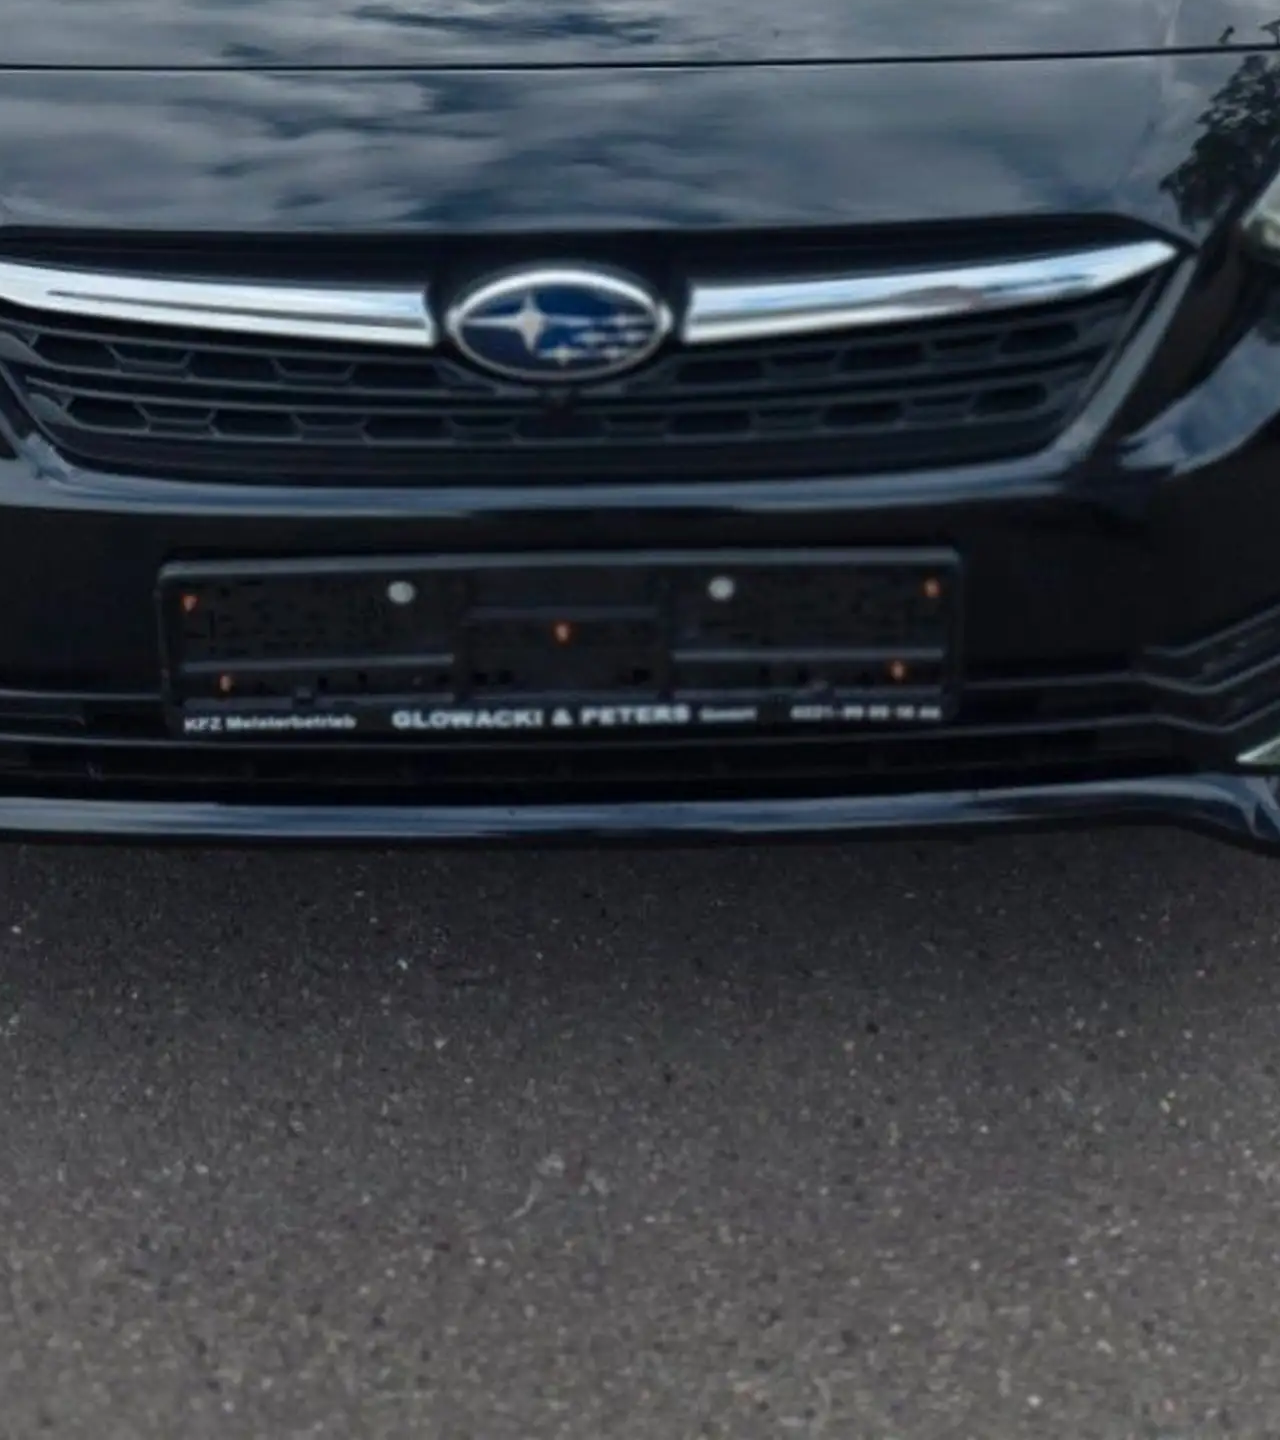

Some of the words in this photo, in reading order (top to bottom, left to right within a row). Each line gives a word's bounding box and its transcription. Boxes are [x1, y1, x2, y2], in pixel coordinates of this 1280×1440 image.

[392, 709, 543, 728] GLOWACKI
[552, 708, 572, 726] &
[581, 705, 689, 725] PETERS
